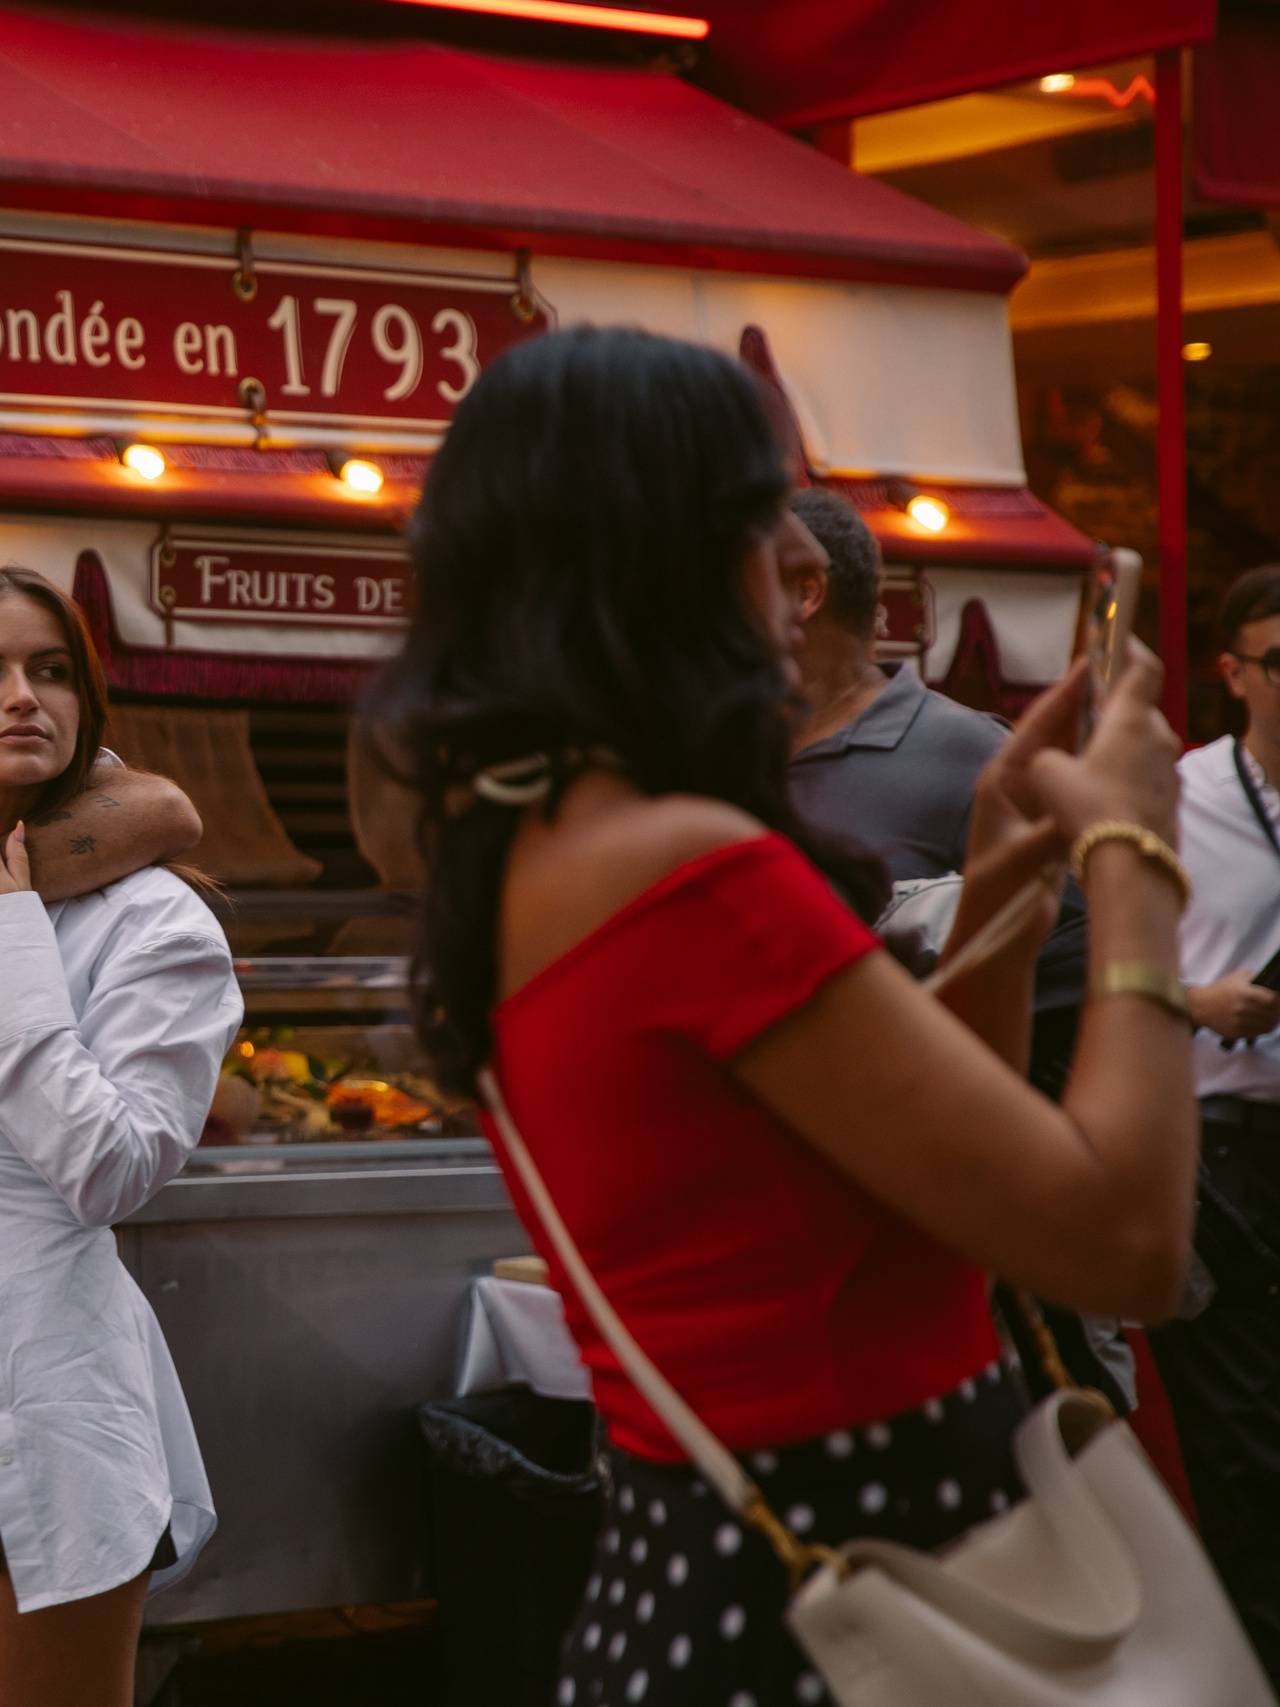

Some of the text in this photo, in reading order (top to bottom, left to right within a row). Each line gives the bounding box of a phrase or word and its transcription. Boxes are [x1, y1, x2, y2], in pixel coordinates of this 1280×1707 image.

[173, 321, 239, 377] en
[267, 294, 481, 404] 1793
[194, 554, 336, 609] FRUITS
